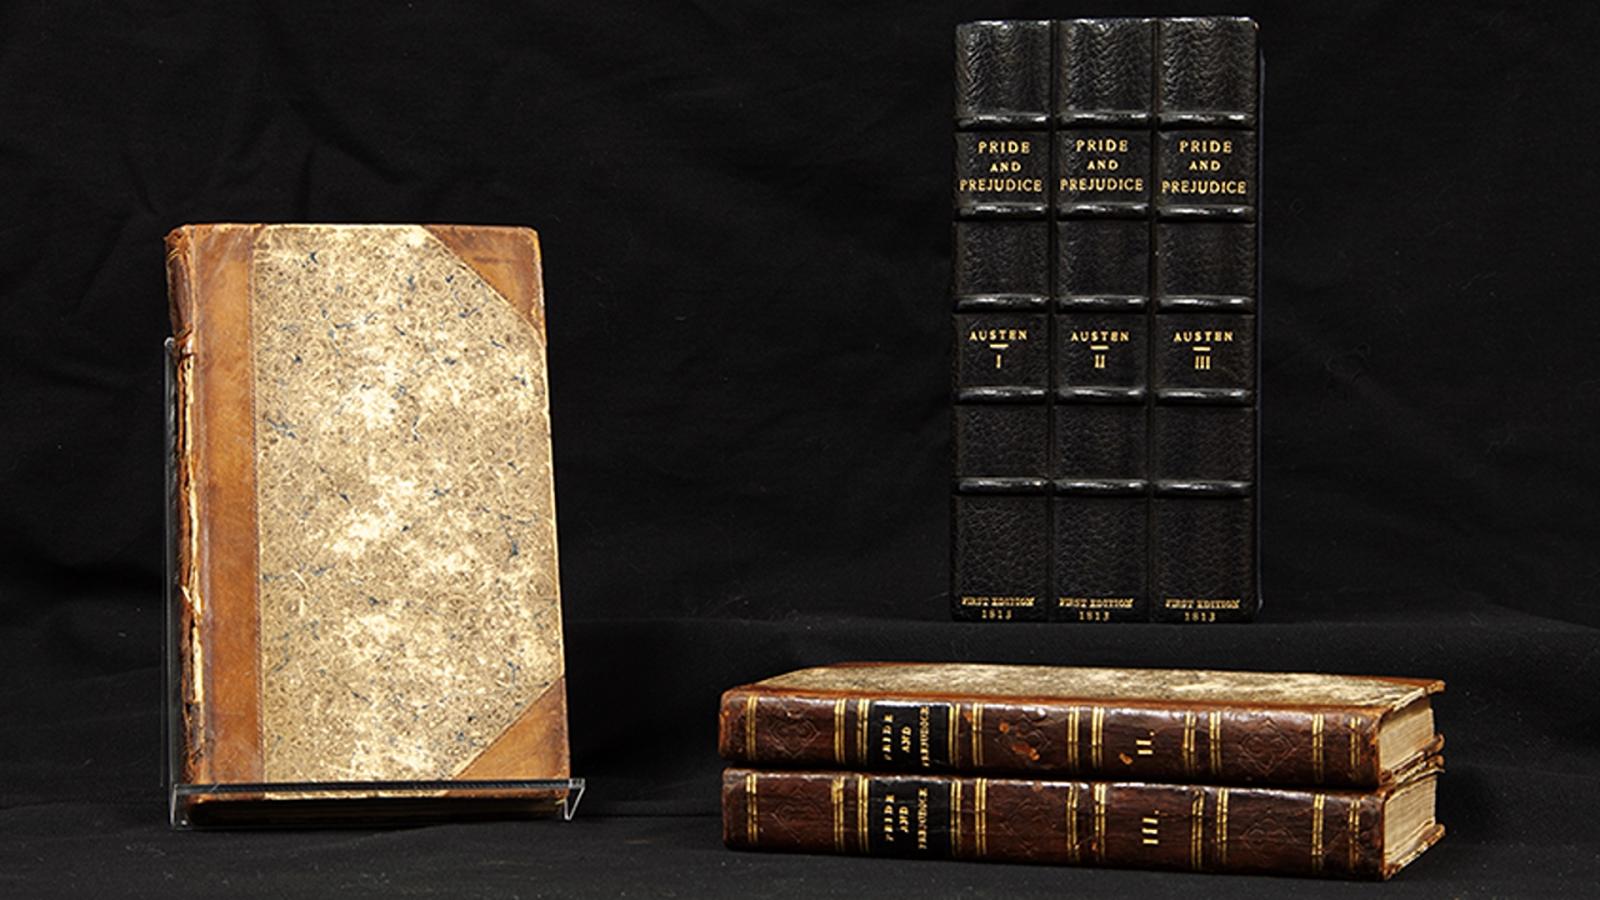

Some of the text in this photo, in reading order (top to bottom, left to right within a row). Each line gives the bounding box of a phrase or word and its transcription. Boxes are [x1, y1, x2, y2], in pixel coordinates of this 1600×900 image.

[978, 140, 1031, 155] PRIDE
[1075, 138, 1129, 153] PRIDE
[1179, 139, 1232, 154] PRIDE
[990, 160, 1022, 173] AND
[1087, 159, 1119, 171] AND
[1188, 159, 1221, 172] AND
[959, 177, 1042, 193] PREJUDICE
[1059, 177, 1143, 192] PREJUDICE
[1161, 179, 1247, 194] PREJUDICE
[968, 329, 1028, 342] AUSTEN
[1071, 330, 1130, 343] AUSTEN
[1173, 330, 1234, 343] AUSTEN
[995, 353, 1002, 369] I
[1094, 353, 1106, 369] II
[1194, 355, 1211, 370] III
